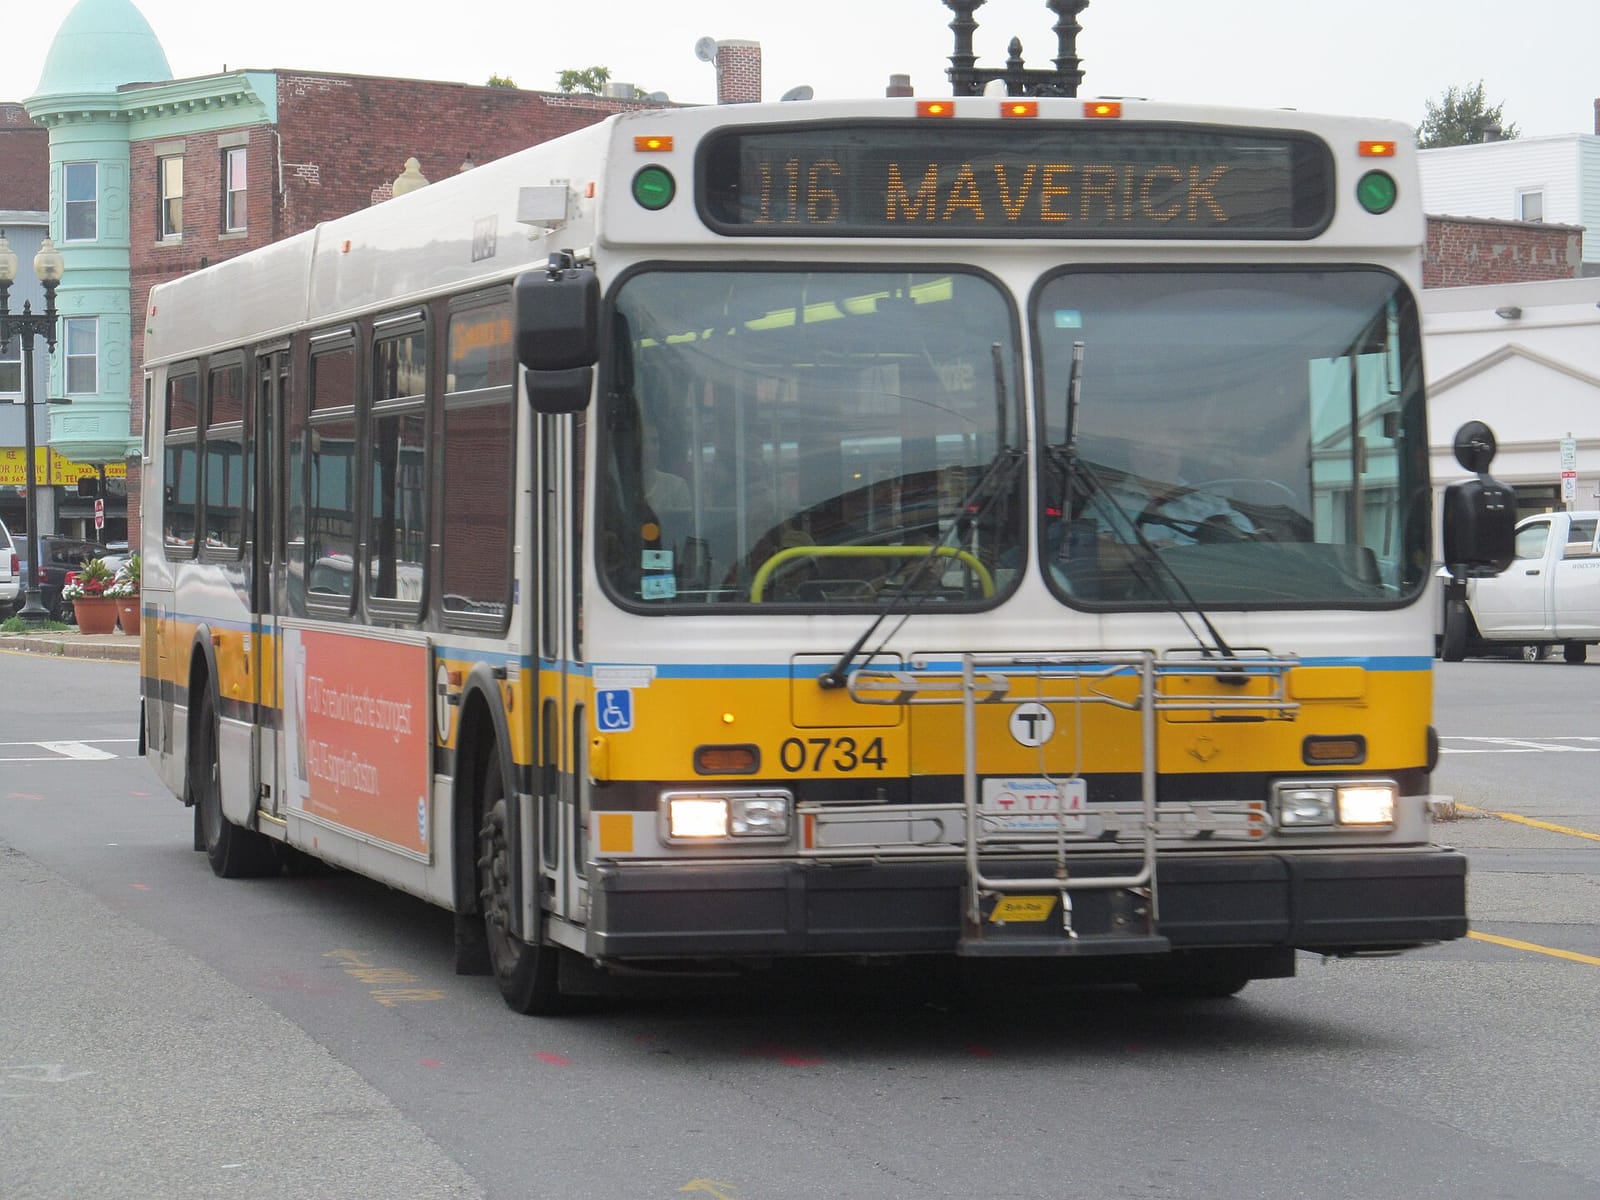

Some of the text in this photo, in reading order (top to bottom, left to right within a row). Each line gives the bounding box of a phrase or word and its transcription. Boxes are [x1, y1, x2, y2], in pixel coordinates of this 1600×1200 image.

[752, 157, 1228, 226] 116 MAVERICK
[14, 464, 44, 474] PAIC
[1018, 713, 1046, 740] T
[780, 737, 887, 773] 0734
